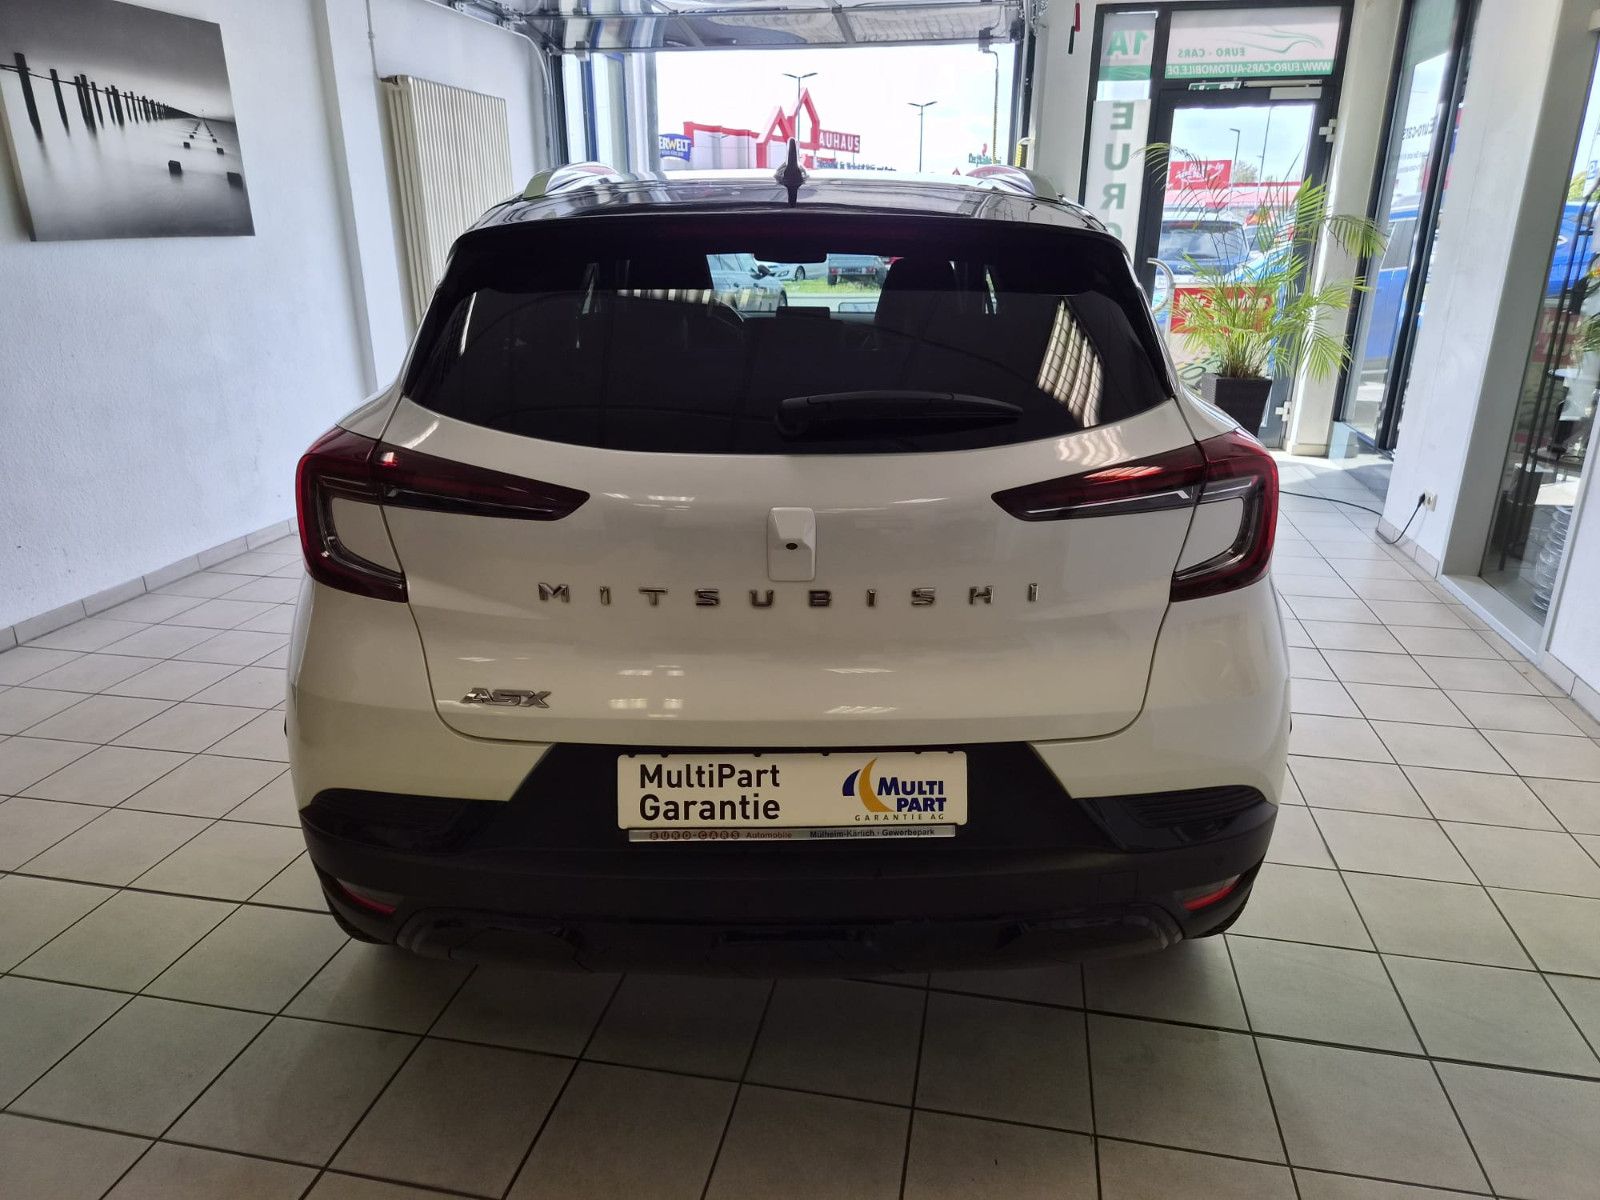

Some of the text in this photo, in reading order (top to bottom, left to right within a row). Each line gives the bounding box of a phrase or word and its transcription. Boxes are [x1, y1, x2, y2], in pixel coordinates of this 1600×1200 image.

[537, 581, 1039, 607] MITSUBISHI
[460, 687, 552, 708] ASX
[640, 763, 780, 788] MultiPart
[640, 793, 780, 821] Garantie
[896, 797, 947, 812] PART
[855, 813, 922, 821] GARANTIE
[746, 831, 793, 839] Automobile
[881, 828, 935, 838] Gewerbepark
